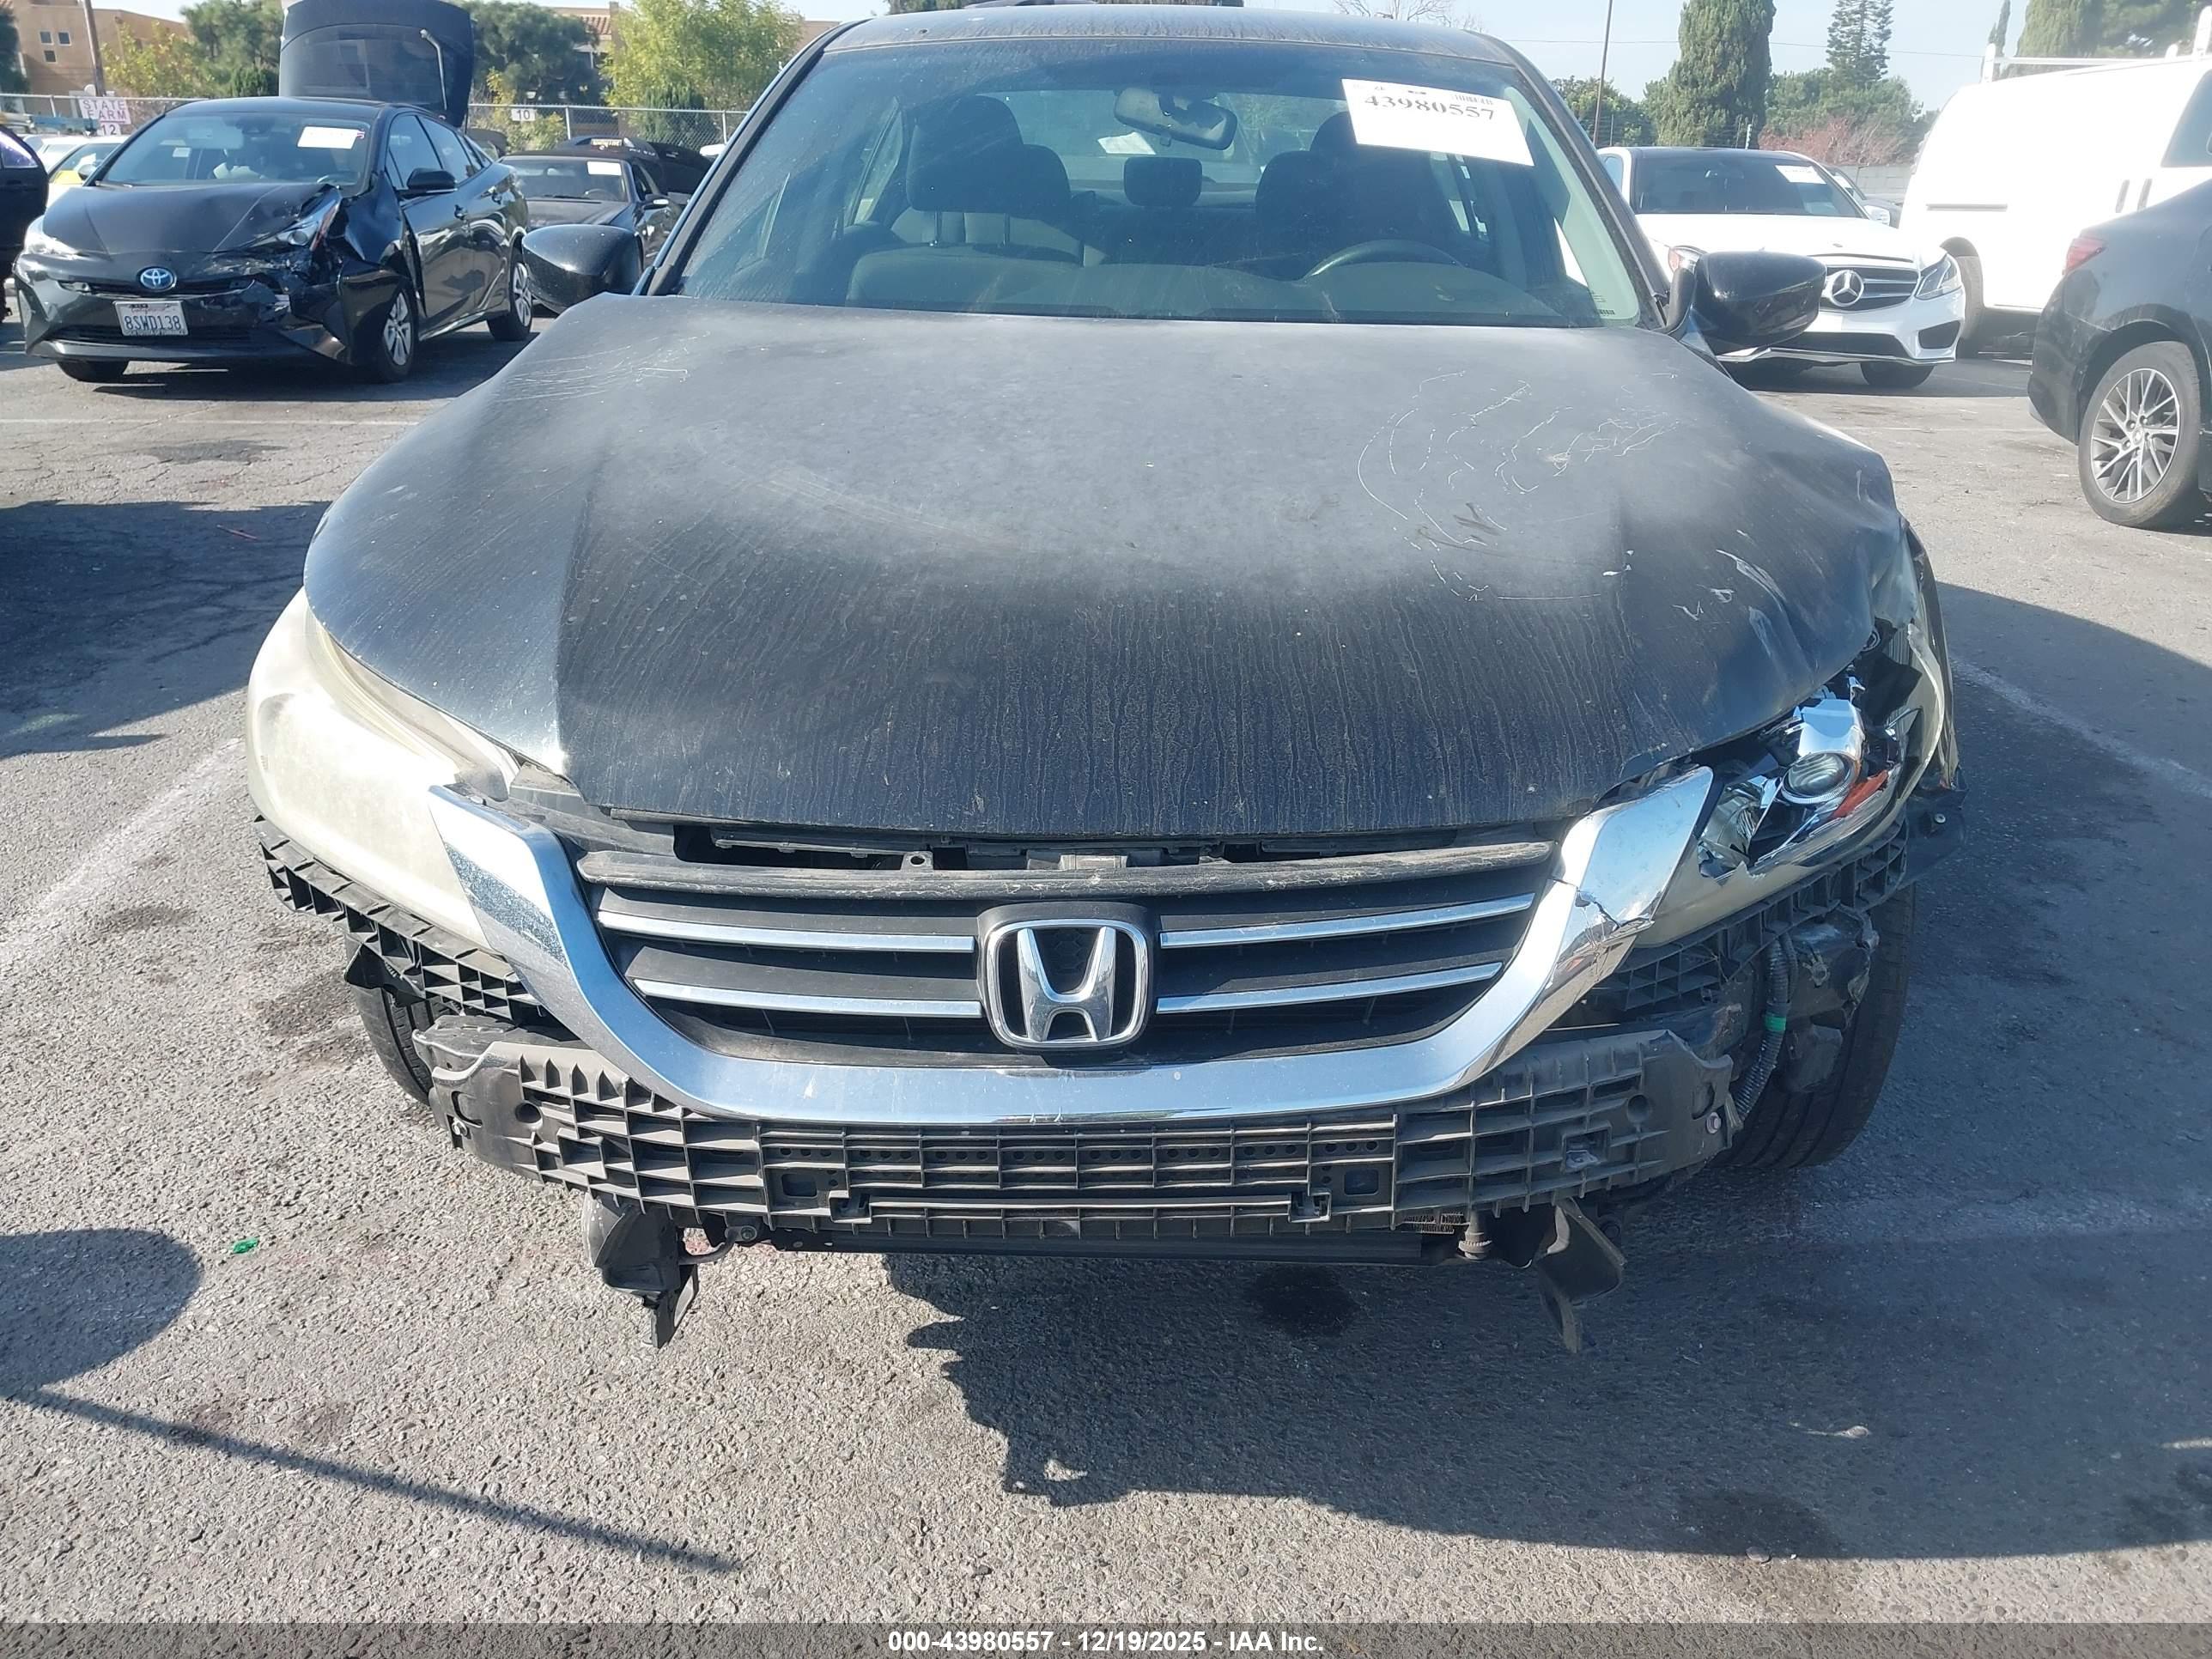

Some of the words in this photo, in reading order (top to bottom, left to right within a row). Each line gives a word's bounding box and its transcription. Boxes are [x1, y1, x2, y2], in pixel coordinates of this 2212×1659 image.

[82, 99, 125, 111] STATE
[1364, 94, 1494, 121] 43980557
[88, 109, 127, 119] FARM
[516, 109, 531, 120] 10
[101, 124, 118, 136] 12
[124, 315, 182, 331] 8SWD138
